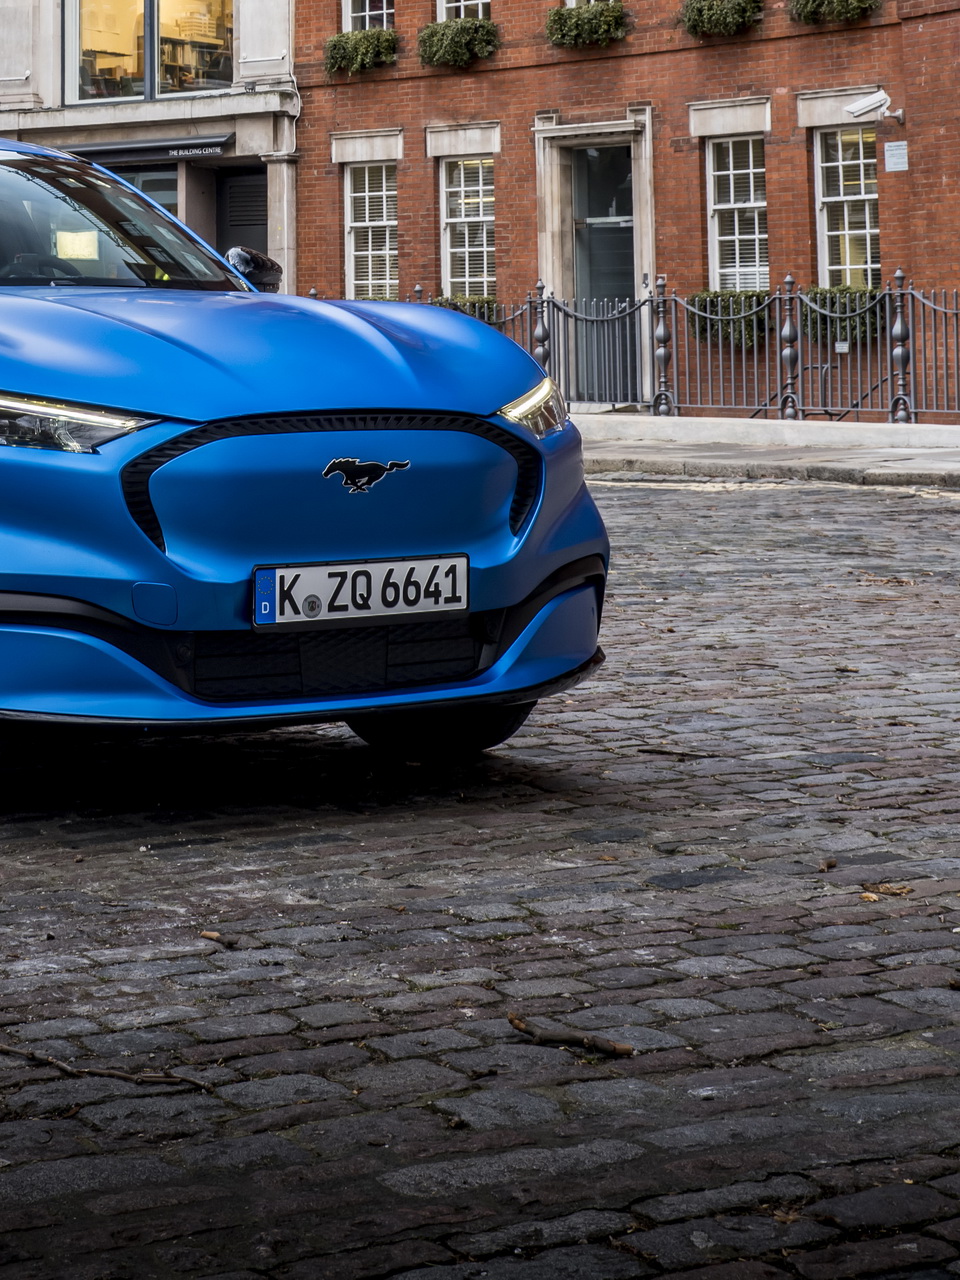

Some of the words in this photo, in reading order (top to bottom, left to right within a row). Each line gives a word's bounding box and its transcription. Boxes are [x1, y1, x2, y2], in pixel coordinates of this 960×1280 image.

[278, 573, 302, 616] K
[327, 570, 372, 613] ZQ
[380, 564, 462, 608] 6641
[261, 601, 270, 614] D
